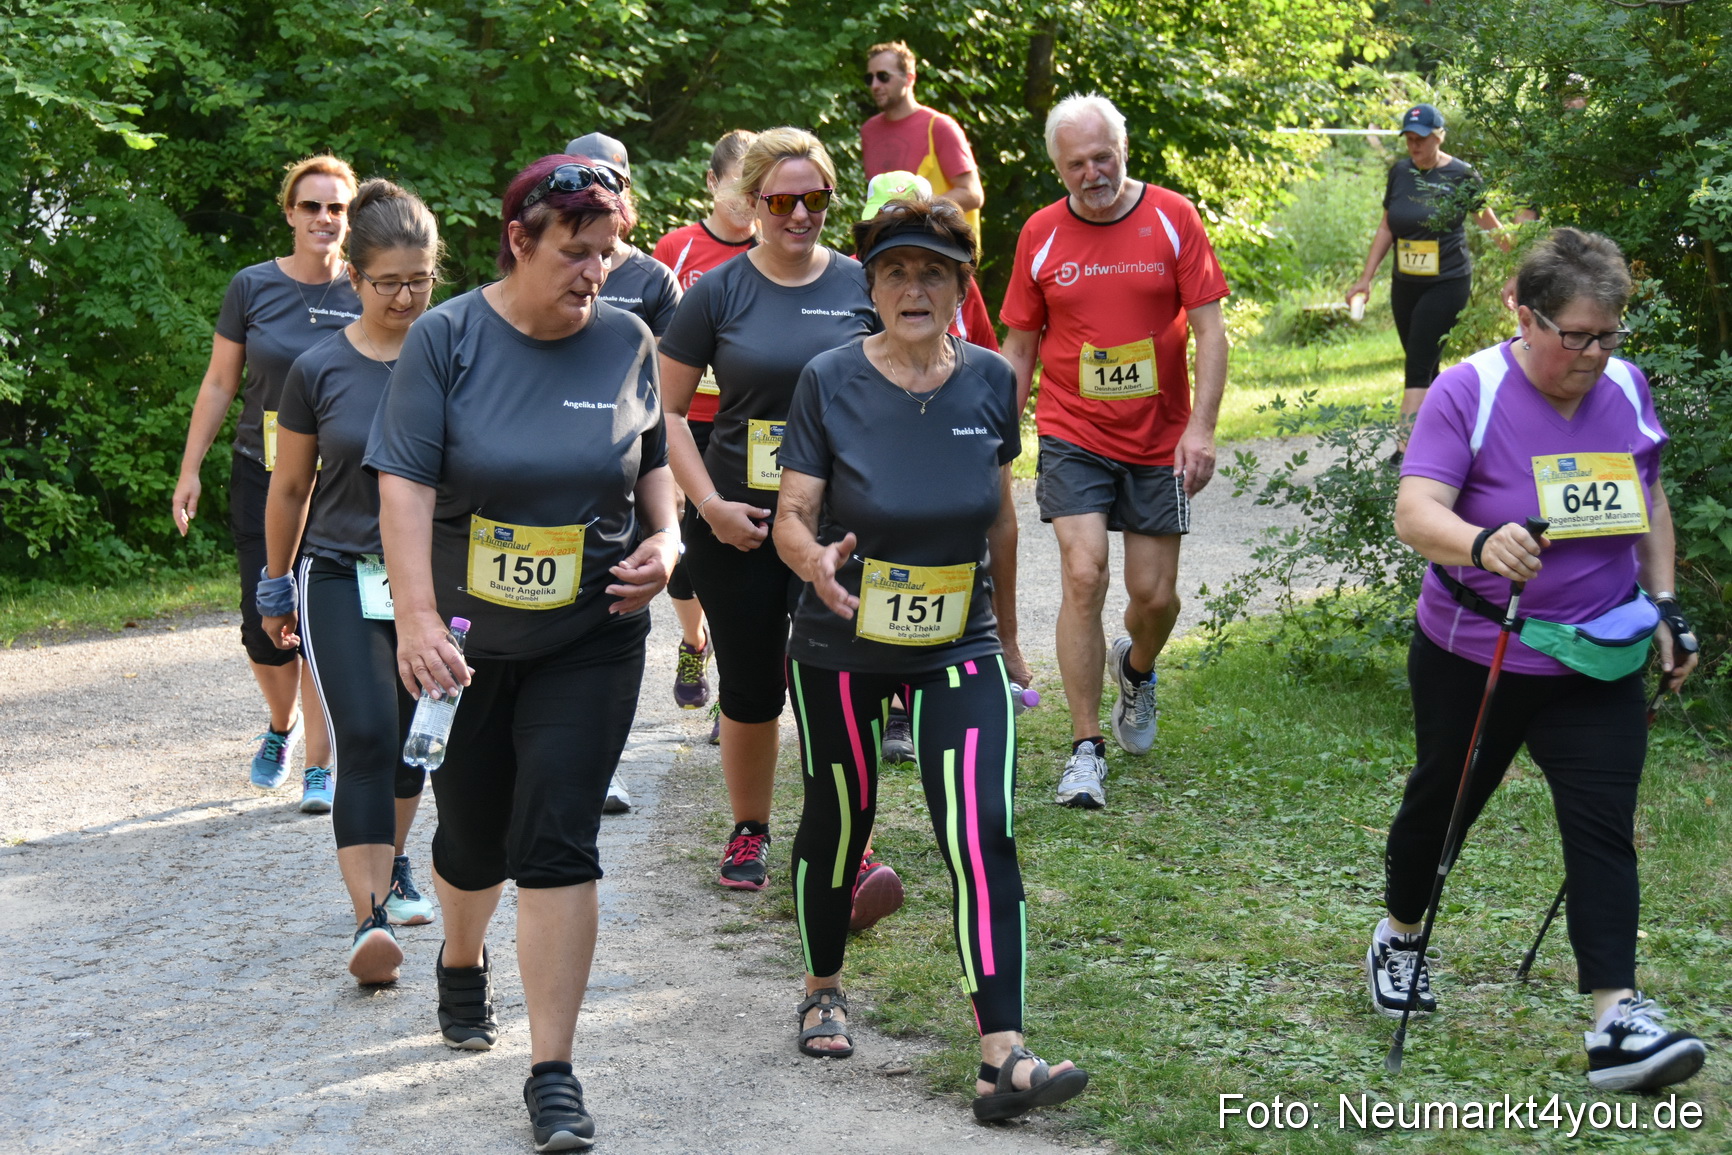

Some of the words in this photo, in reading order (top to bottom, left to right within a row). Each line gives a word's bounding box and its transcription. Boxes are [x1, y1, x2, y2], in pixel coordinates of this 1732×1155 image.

[1404, 253, 1427, 265] 177
[1084, 261, 1165, 275] bfwnürnberg
[330, 310, 361, 319] Königsberge
[801, 308, 830, 316] Dorothea
[1095, 363, 1139, 385] 144
[563, 400, 596, 409] Angelika
[597, 402, 618, 410] Bauer
[762, 434, 783, 442] firme
[952, 427, 975, 436] Thekla
[975, 427, 988, 435] Beck
[1563, 481, 1622, 514] 642
[1548, 514, 1603, 525] Regensburger
[1605, 512, 1641, 520] Marianne
[486, 534, 532, 551] firmenlauf
[493, 553, 557, 587] 150
[490, 581, 515, 593] Bauer
[517, 587, 556, 596] Angelika
[880, 577, 926, 590] firmenlauf
[887, 594, 945, 624] 151
[889, 623, 913, 631] Beck
[914, 624, 941, 632] Thekla
